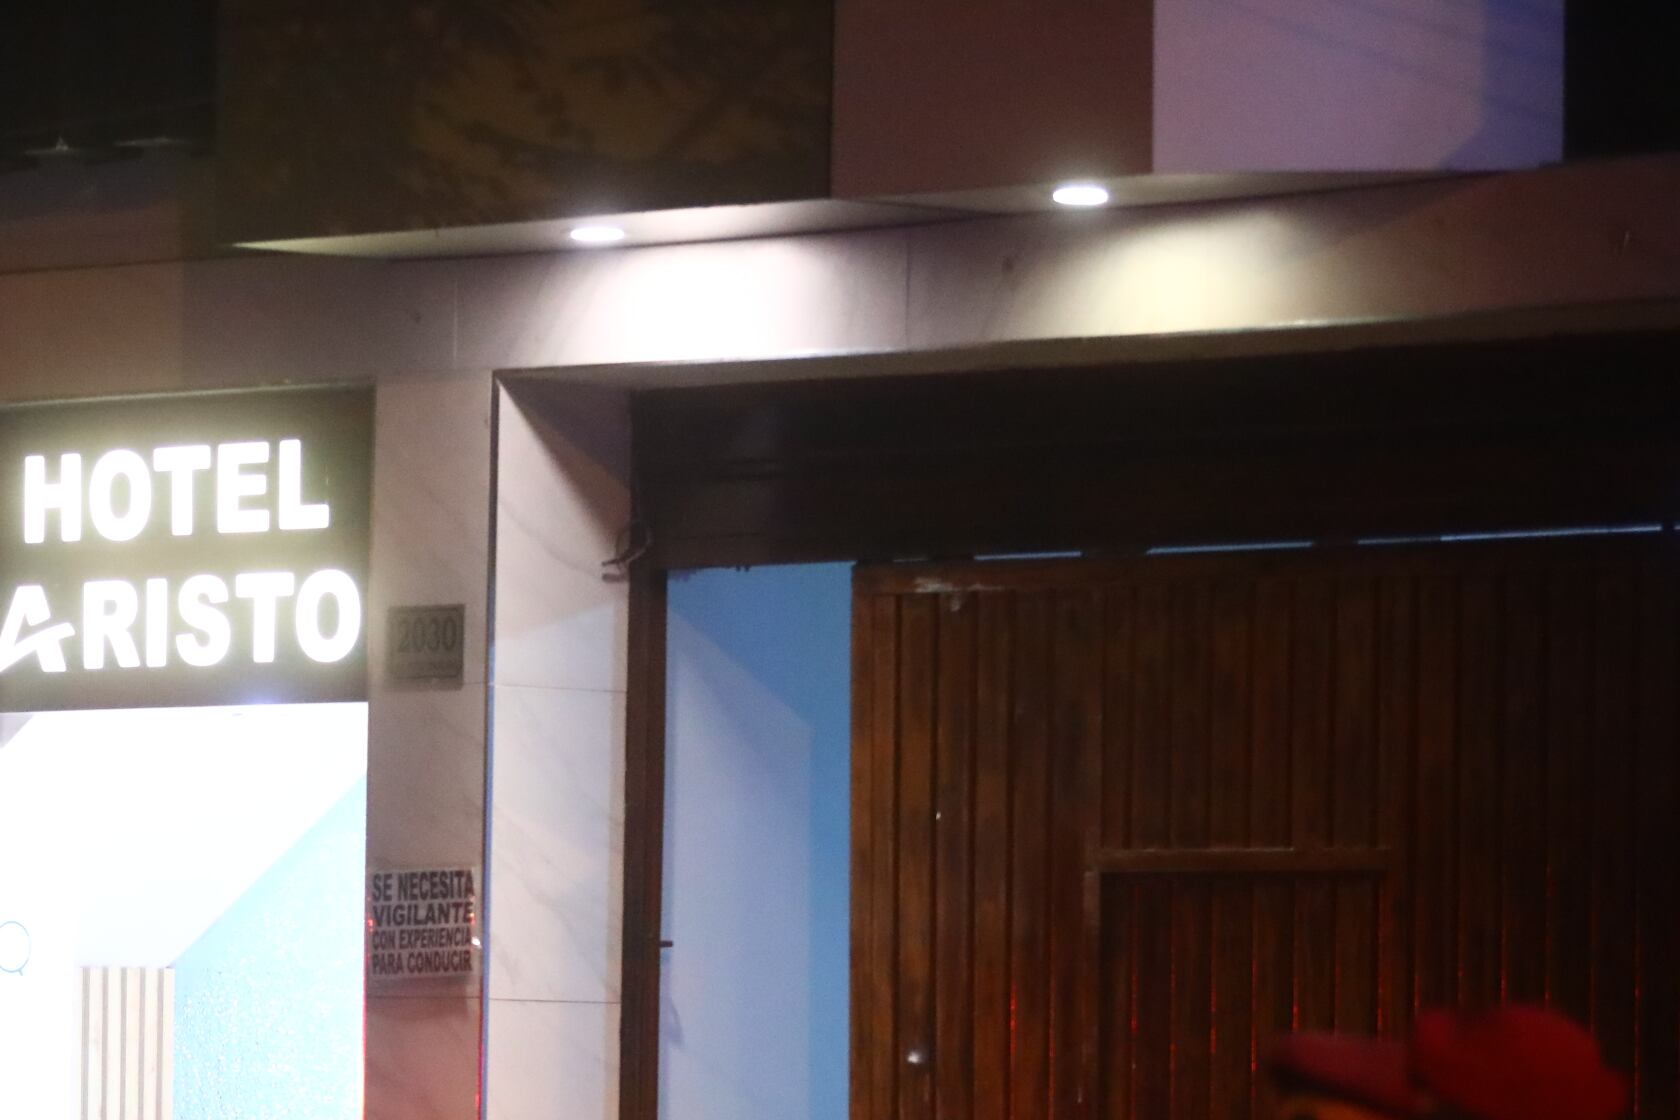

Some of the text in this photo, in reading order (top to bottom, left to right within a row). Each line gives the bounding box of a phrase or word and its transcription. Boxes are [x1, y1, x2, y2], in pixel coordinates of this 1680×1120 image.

[23, 439, 330, 543] HOTEL
[398, 616, 457, 653] 2030
[372, 869, 475, 902] SE NECESITA
[372, 901, 475, 927] VIGILANTE
[372, 926, 472, 950] CON EXPERIENCIA
[372, 950, 472, 974] PARA CONDUCIR
